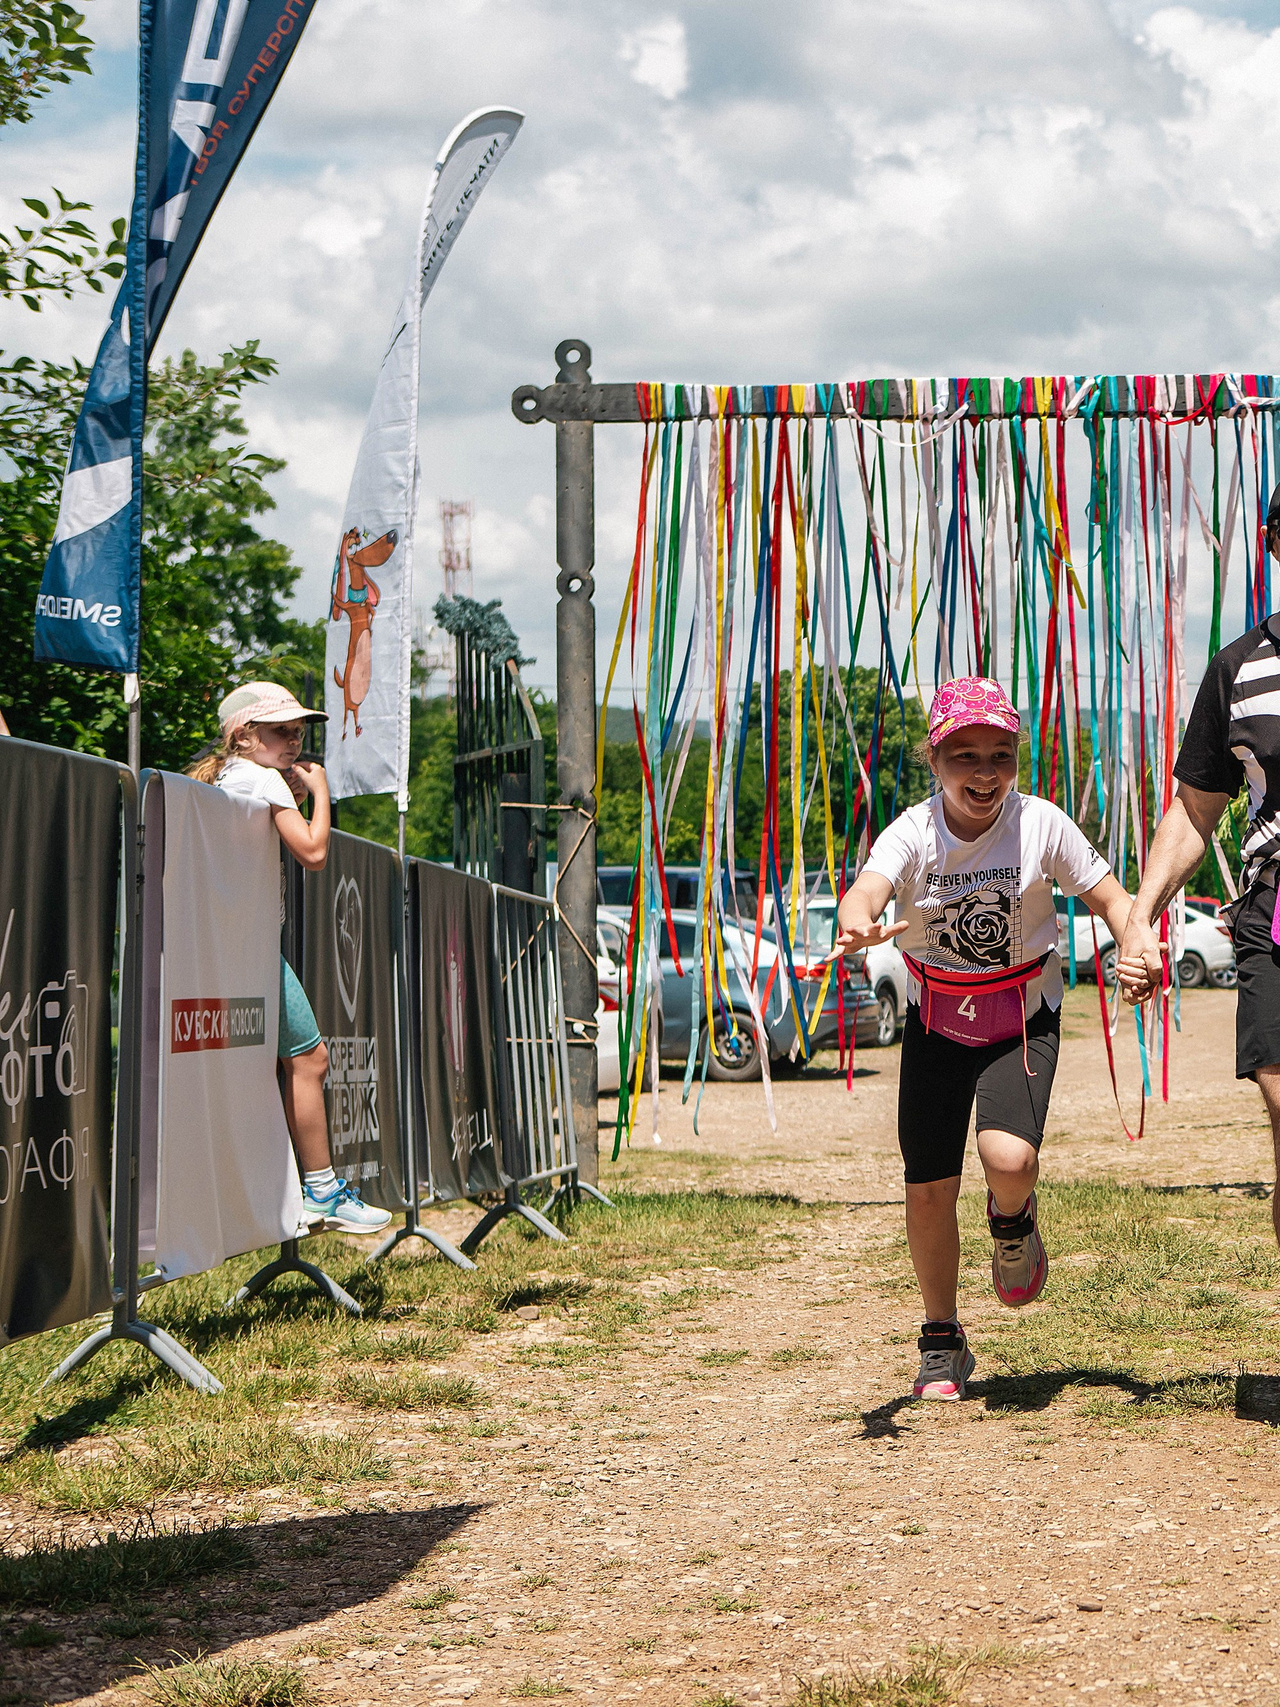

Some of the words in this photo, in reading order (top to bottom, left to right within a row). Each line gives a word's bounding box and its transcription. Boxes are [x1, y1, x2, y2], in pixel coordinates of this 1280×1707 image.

[925, 872, 962, 888] BEIEVE
[962, 872, 973, 885] IN
[973, 866, 1021, 882] YOURSELF
[230, 1007, 264, 1037] НОВОСТИ
[957, 994, 977, 1022] 4
[332, 1082, 380, 1155] ДВИЖ
